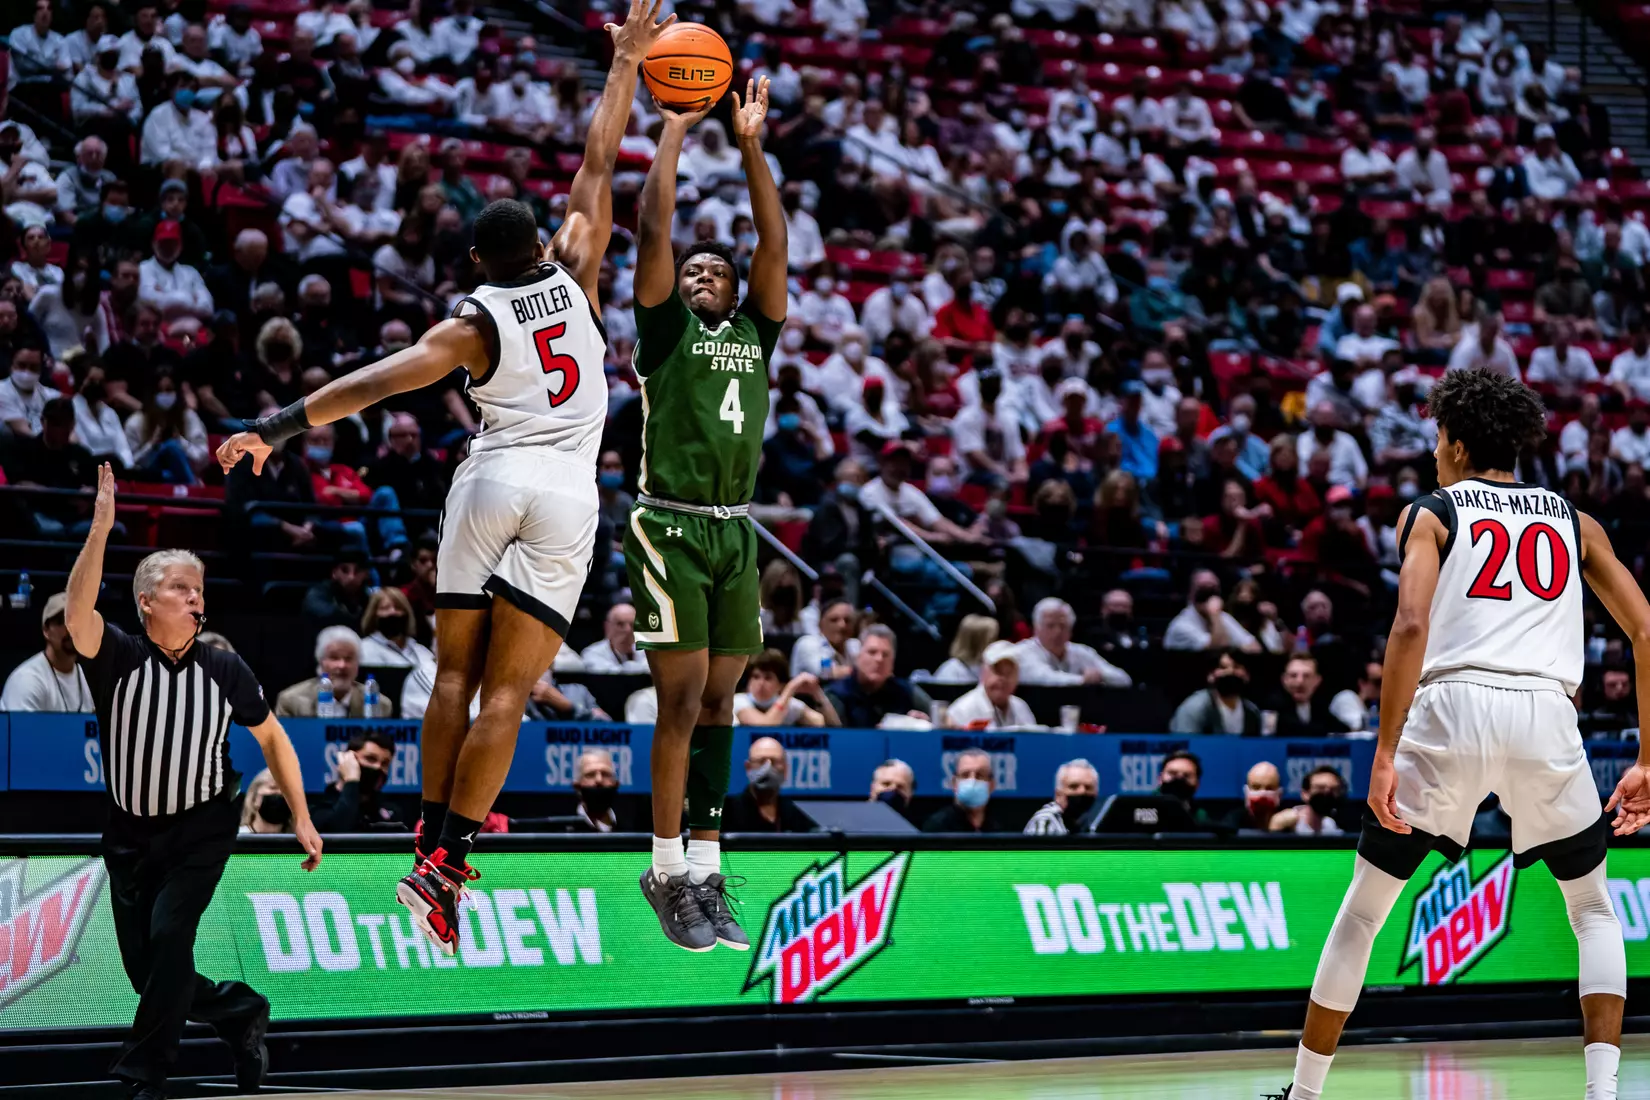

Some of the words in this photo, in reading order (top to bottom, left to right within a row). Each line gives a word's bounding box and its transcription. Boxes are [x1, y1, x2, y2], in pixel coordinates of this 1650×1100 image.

[668, 66, 715, 82] ELITE
[510, 284, 572, 325] BUTLER
[532, 320, 580, 408] 5
[692, 341, 762, 361] COLORAD
[710, 356, 754, 373] STATE
[719, 378, 745, 434] 4
[1452, 489, 1570, 521] BAKER-MAZARA
[1466, 518, 1570, 601] 20
[244, 891, 361, 973] DO
[458, 888, 603, 967] DEW
[1012, 883, 1106, 954] DO
[1099, 903, 1181, 952] THE
[1161, 881, 1290, 950] DEW
